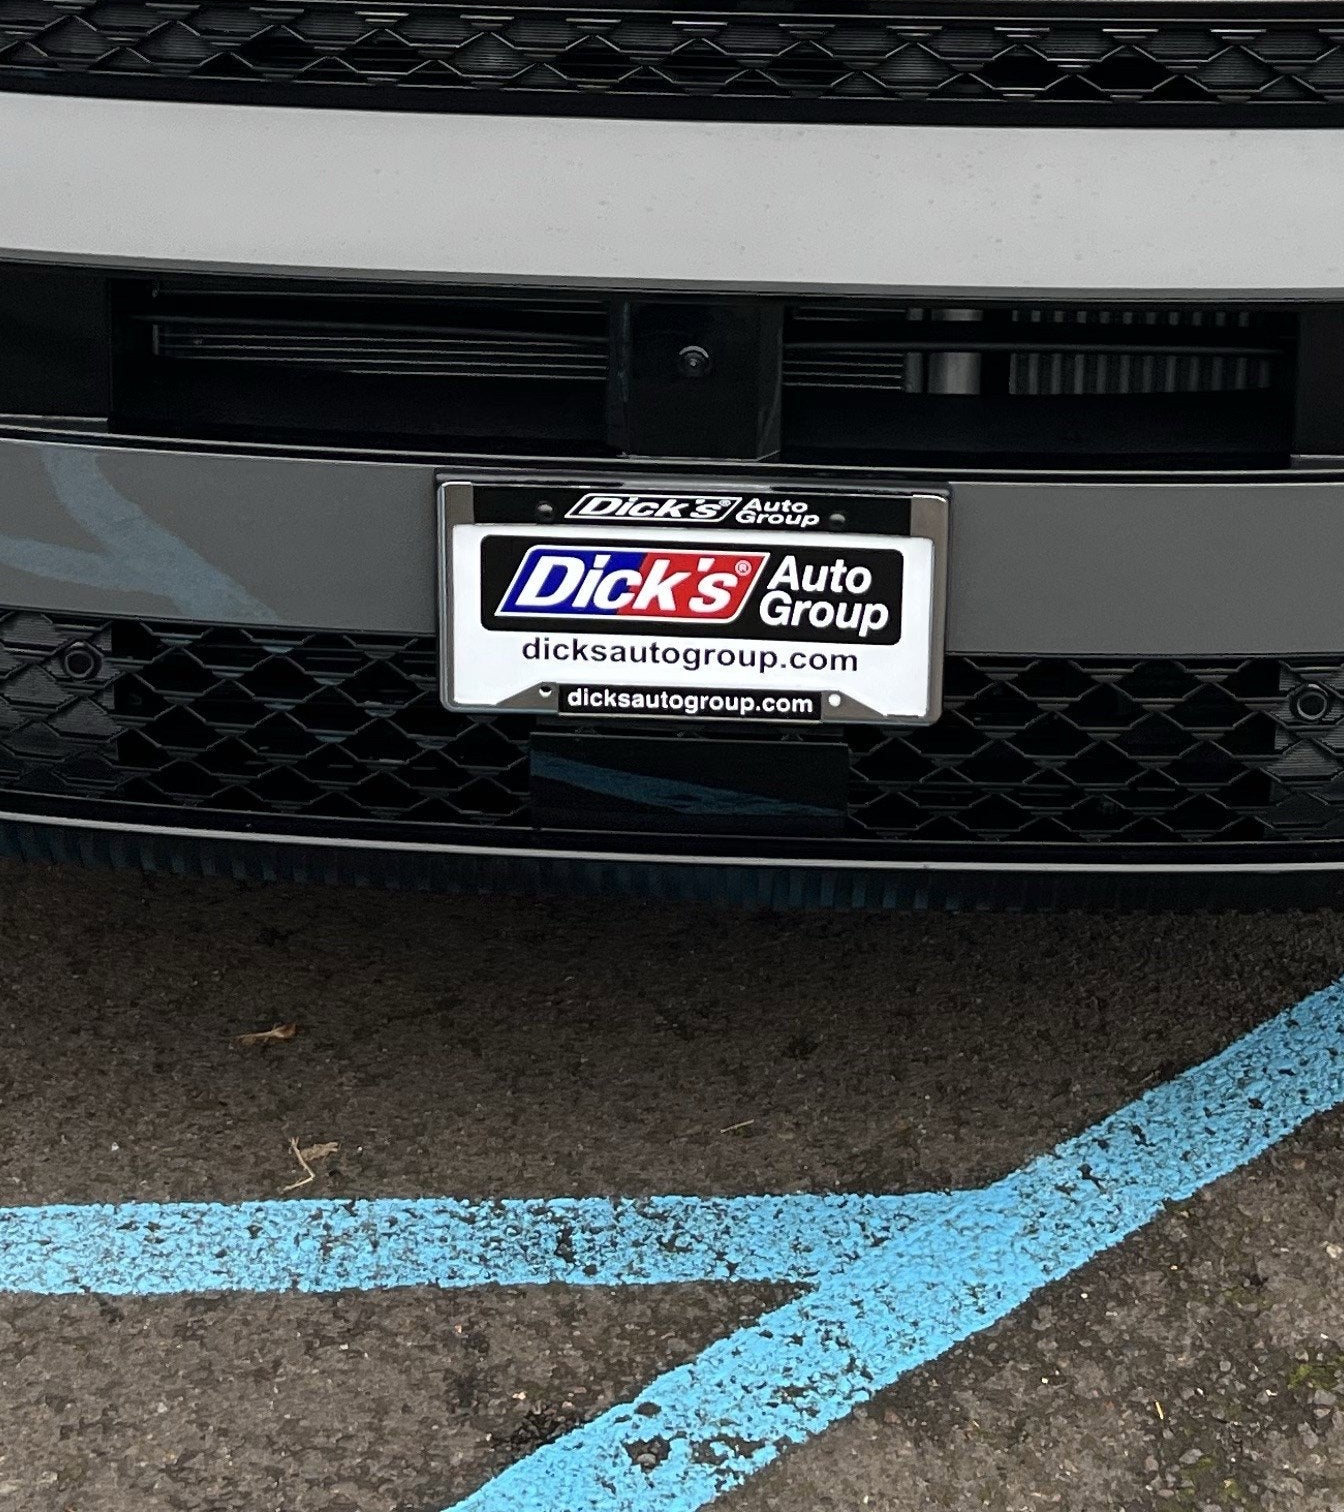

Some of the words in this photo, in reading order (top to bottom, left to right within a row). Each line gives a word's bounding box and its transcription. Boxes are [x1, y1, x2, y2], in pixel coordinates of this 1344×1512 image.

[578, 495, 722, 519] Dick's
[742, 498, 808, 513] Auto
[735, 510, 820, 527] Group
[514, 554, 737, 614] Dick's
[767, 555, 872, 595] Auto
[759, 591, 889, 637] Group
[522, 638, 858, 672] dicksautogroup.com
[567, 688, 813, 714] dicksautogroup.com
